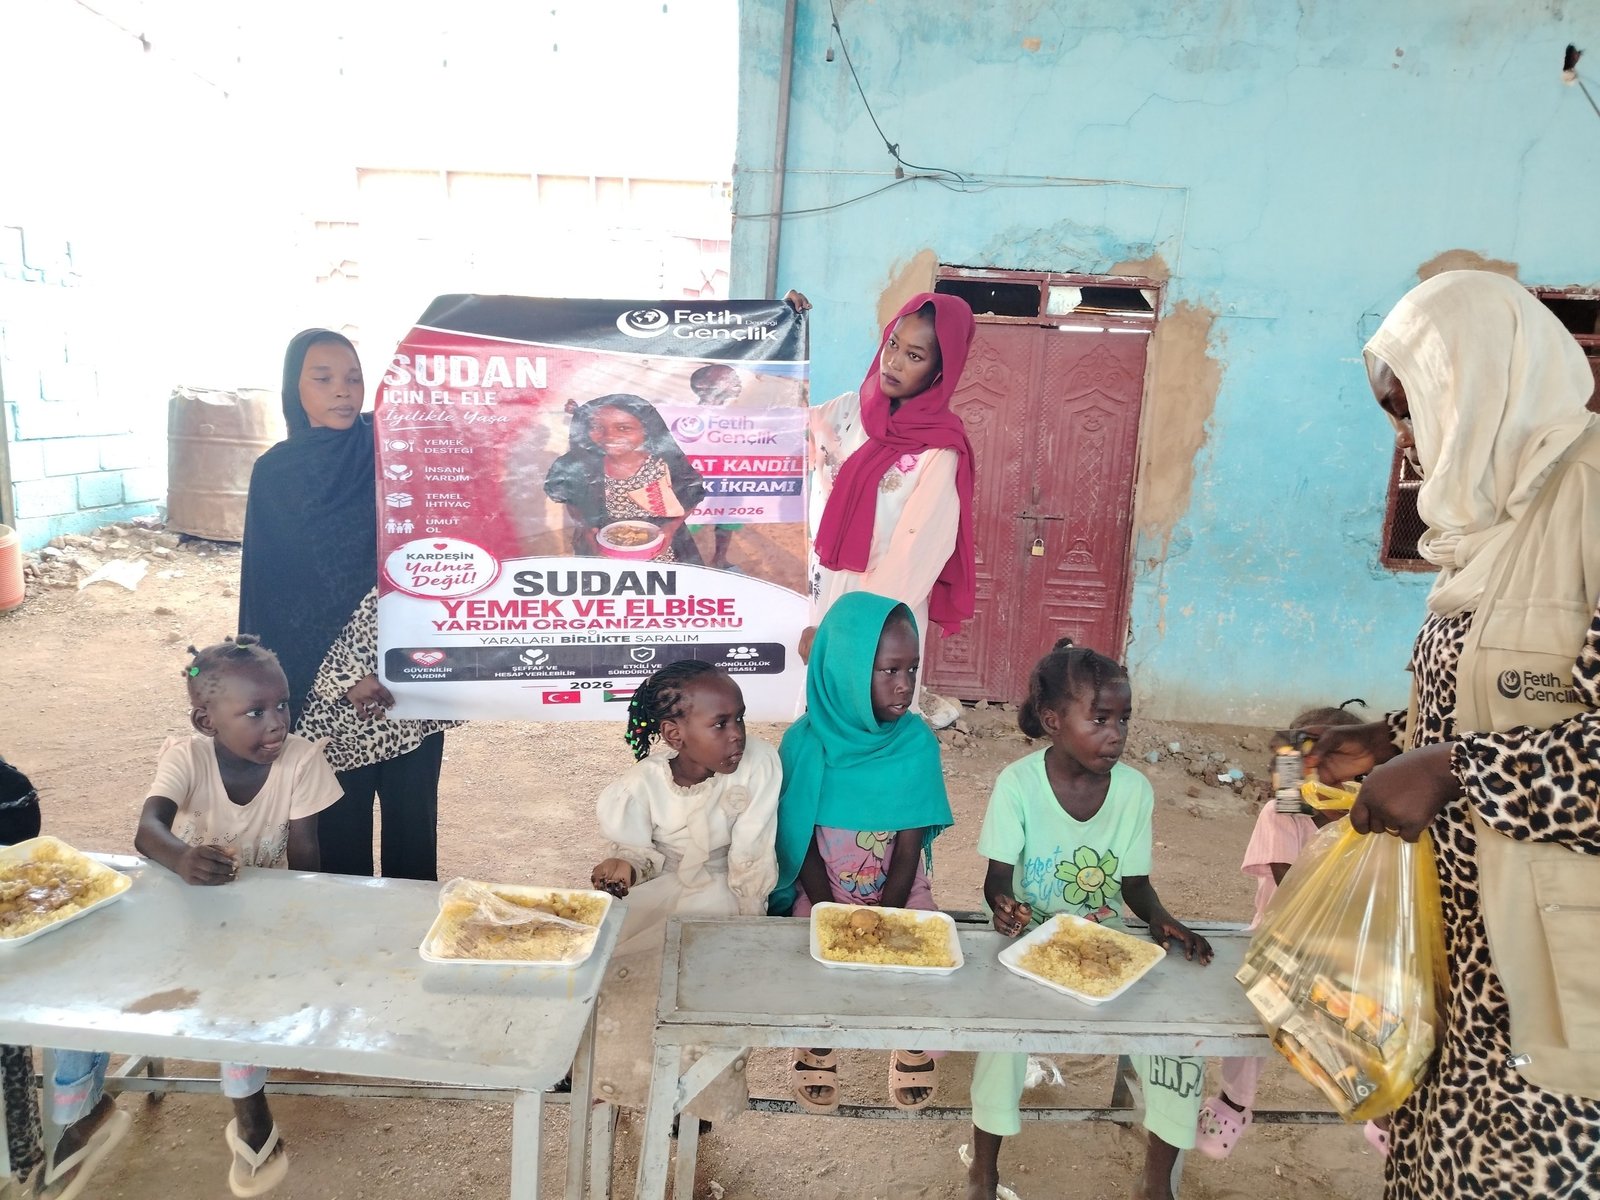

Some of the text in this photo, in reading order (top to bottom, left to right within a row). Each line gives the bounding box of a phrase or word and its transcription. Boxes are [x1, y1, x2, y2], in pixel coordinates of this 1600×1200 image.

[673, 309, 742, 325] Fetih
[672, 325, 778, 342] Gençlik
[383, 353, 547, 389] SUDAN
[431, 390, 455, 405] EL
[461, 391, 497, 406] ELE
[708, 416, 754, 430] Fetih
[707, 430, 777, 445] Gençlik
[425, 465, 465, 473] İNSANİ
[691, 459, 718, 472] AT
[719, 478, 796, 493] İKRAMI
[425, 500, 471, 509] İHTİYAÇ
[728, 507, 764, 516] 2026
[406, 551, 474, 561] KARDEŞİN
[405, 561, 475, 576] Yalnız
[411, 571, 477, 591] Değil!
[513, 570, 677, 597] SUDAN
[440, 595, 736, 619] YEMEK VE ELBİSE
[431, 616, 743, 632] YARDIM ORGANİZASYONU
[480, 634, 699, 645] YARALARI BİRLİKTE SARALIM
[569, 680, 614, 690] 2026
[1523, 670, 1561, 688] Fetih
